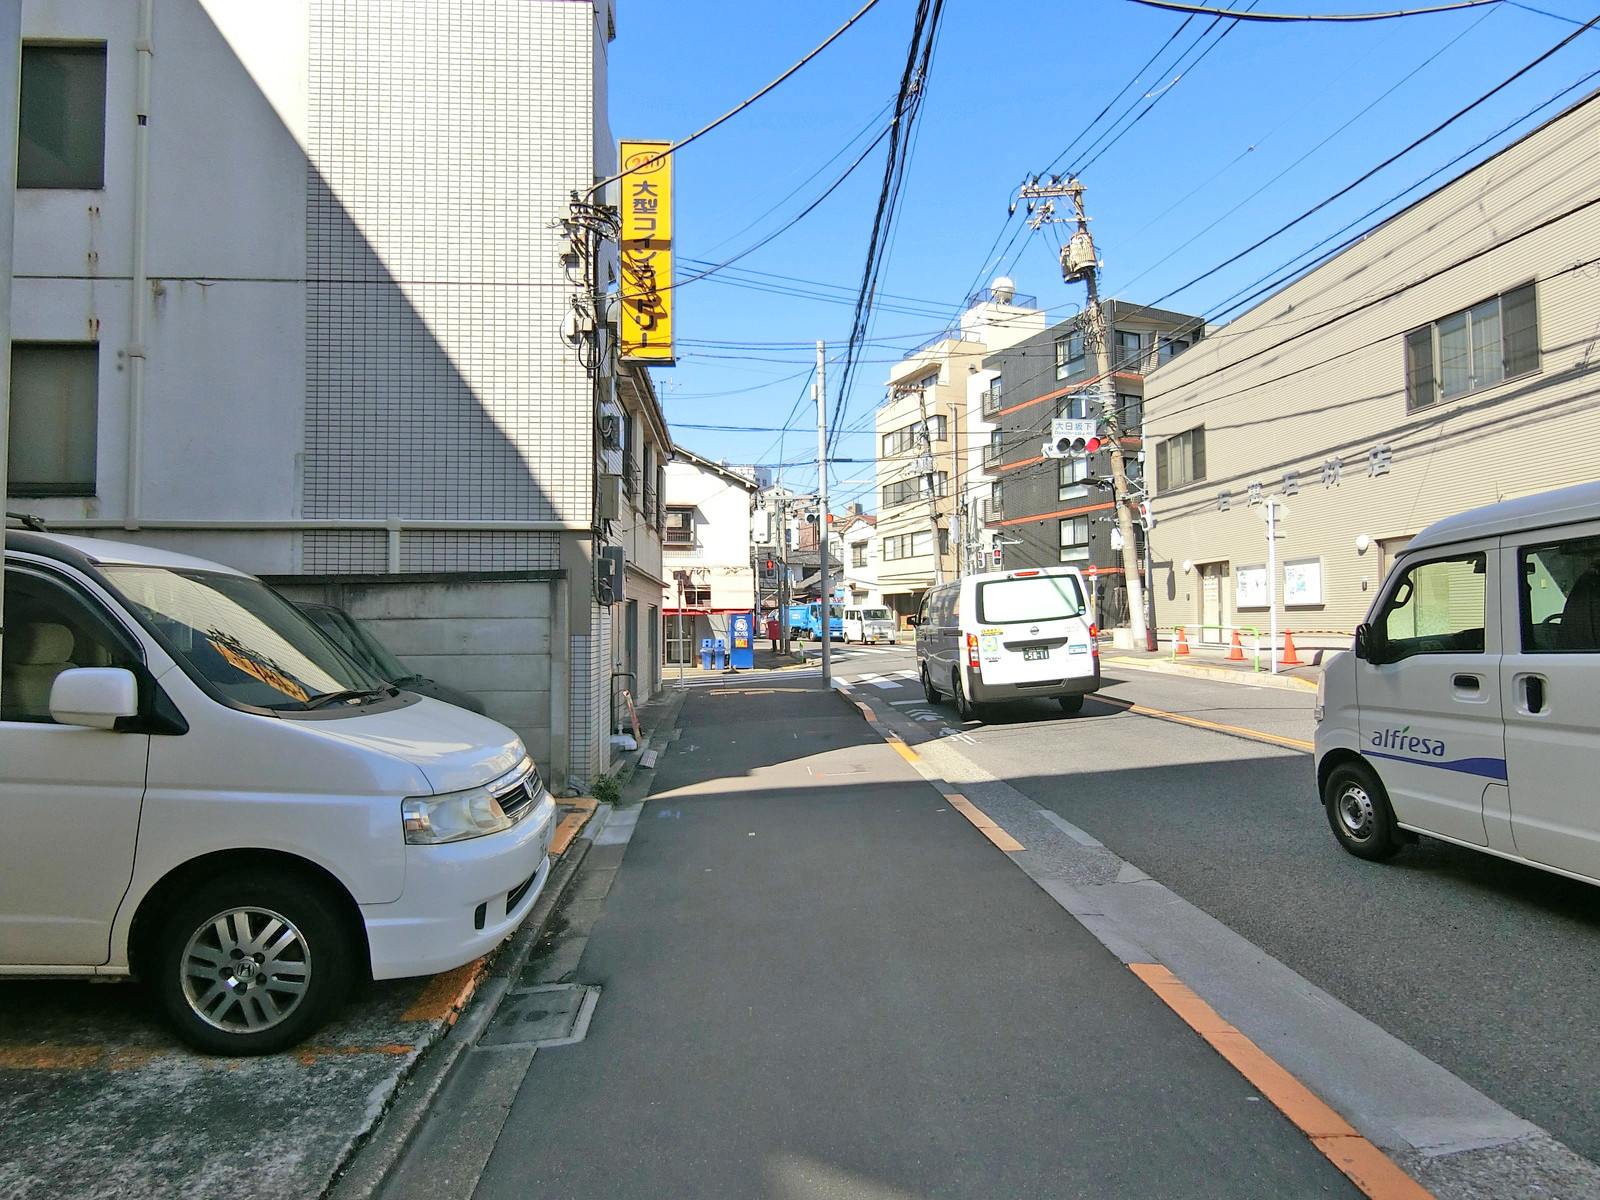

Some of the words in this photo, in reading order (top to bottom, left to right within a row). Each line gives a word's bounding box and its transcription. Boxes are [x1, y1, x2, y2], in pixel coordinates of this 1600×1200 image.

[1056, 422, 1092, 431] 大日坂下
[1371, 728, 1445, 757] alfresa
